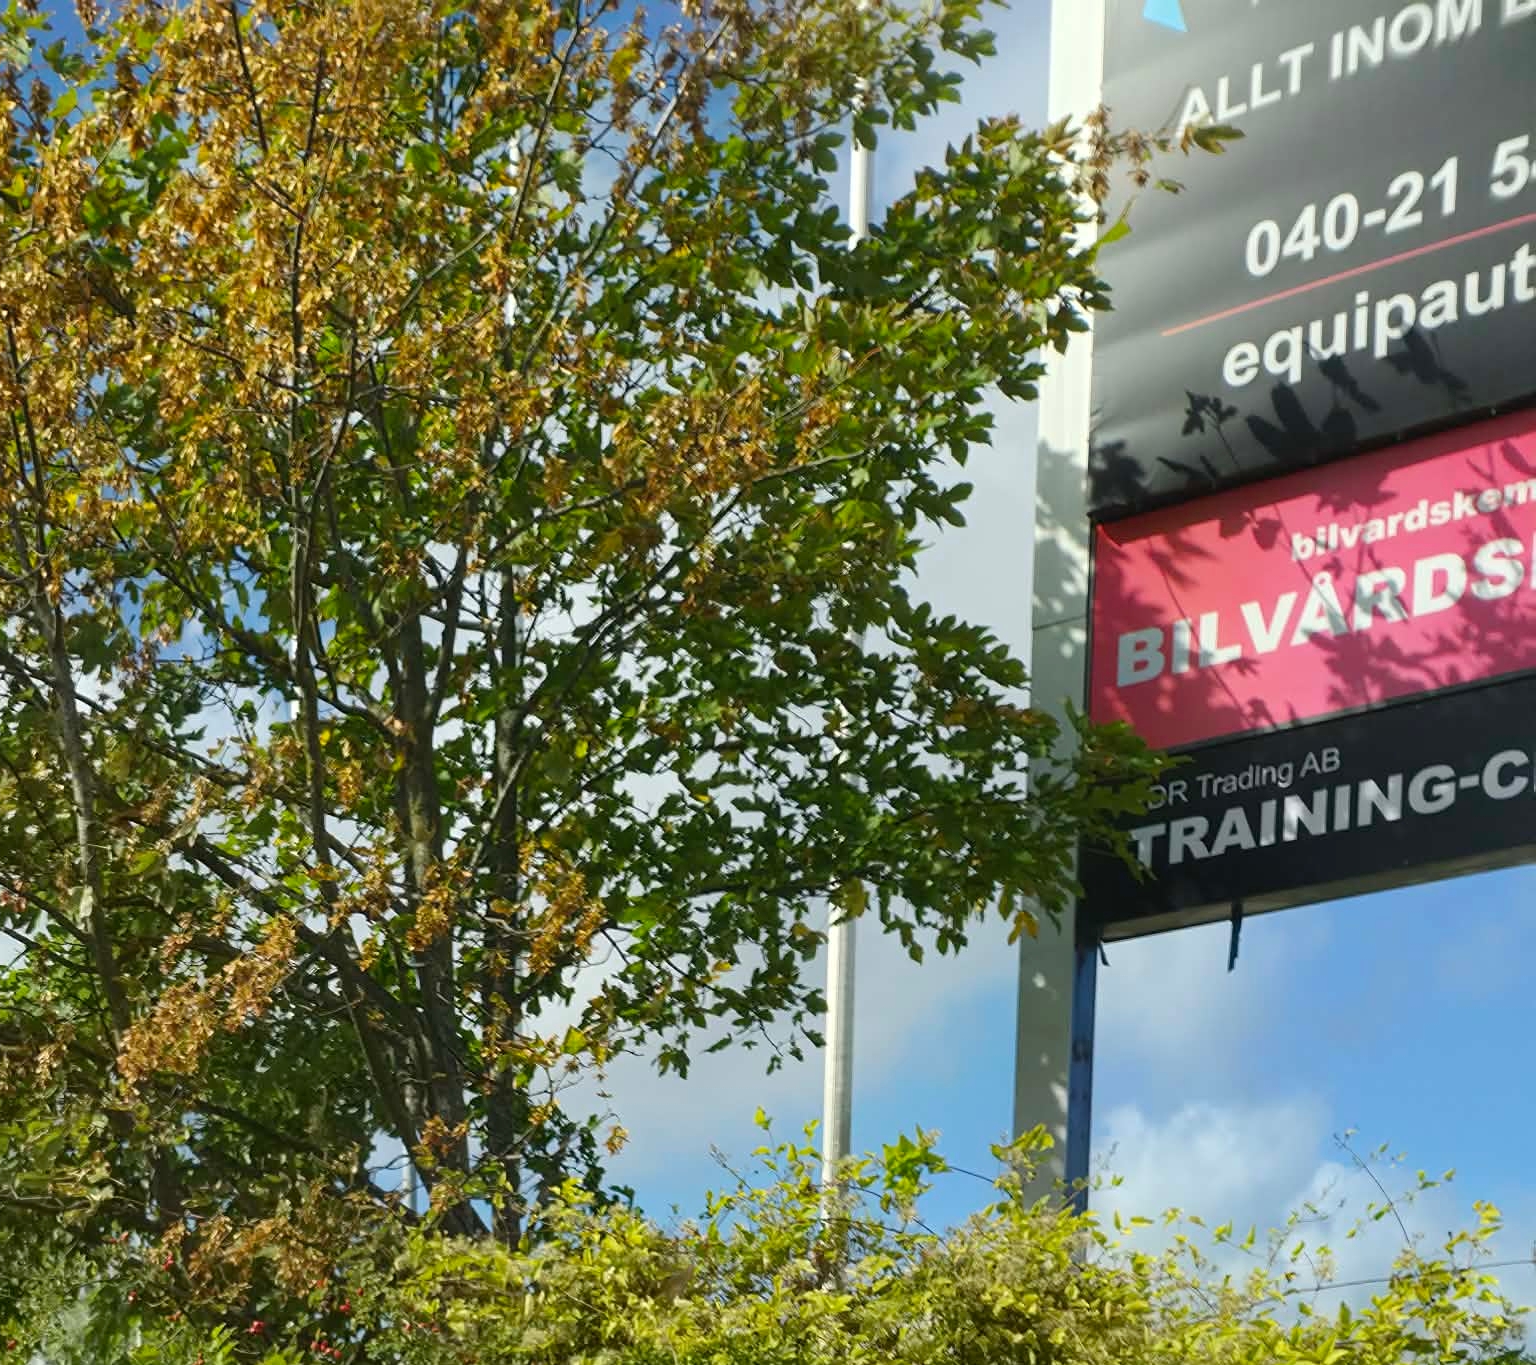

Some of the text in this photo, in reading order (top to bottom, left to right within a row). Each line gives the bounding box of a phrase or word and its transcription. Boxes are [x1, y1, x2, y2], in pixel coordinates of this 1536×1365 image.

[1174, 0, 1483, 142] ALLT INOM
[1245, 132, 1536, 278] 040-21 5
[1221, 241, 1536, 388] equipaut
[1115, 531, 1536, 688] BILVÅRDS
[1129, 748, 1536, 871] TRAINING-C
[1195, 762, 1294, 799] Trading
[1299, 746, 1341, 778] AB
